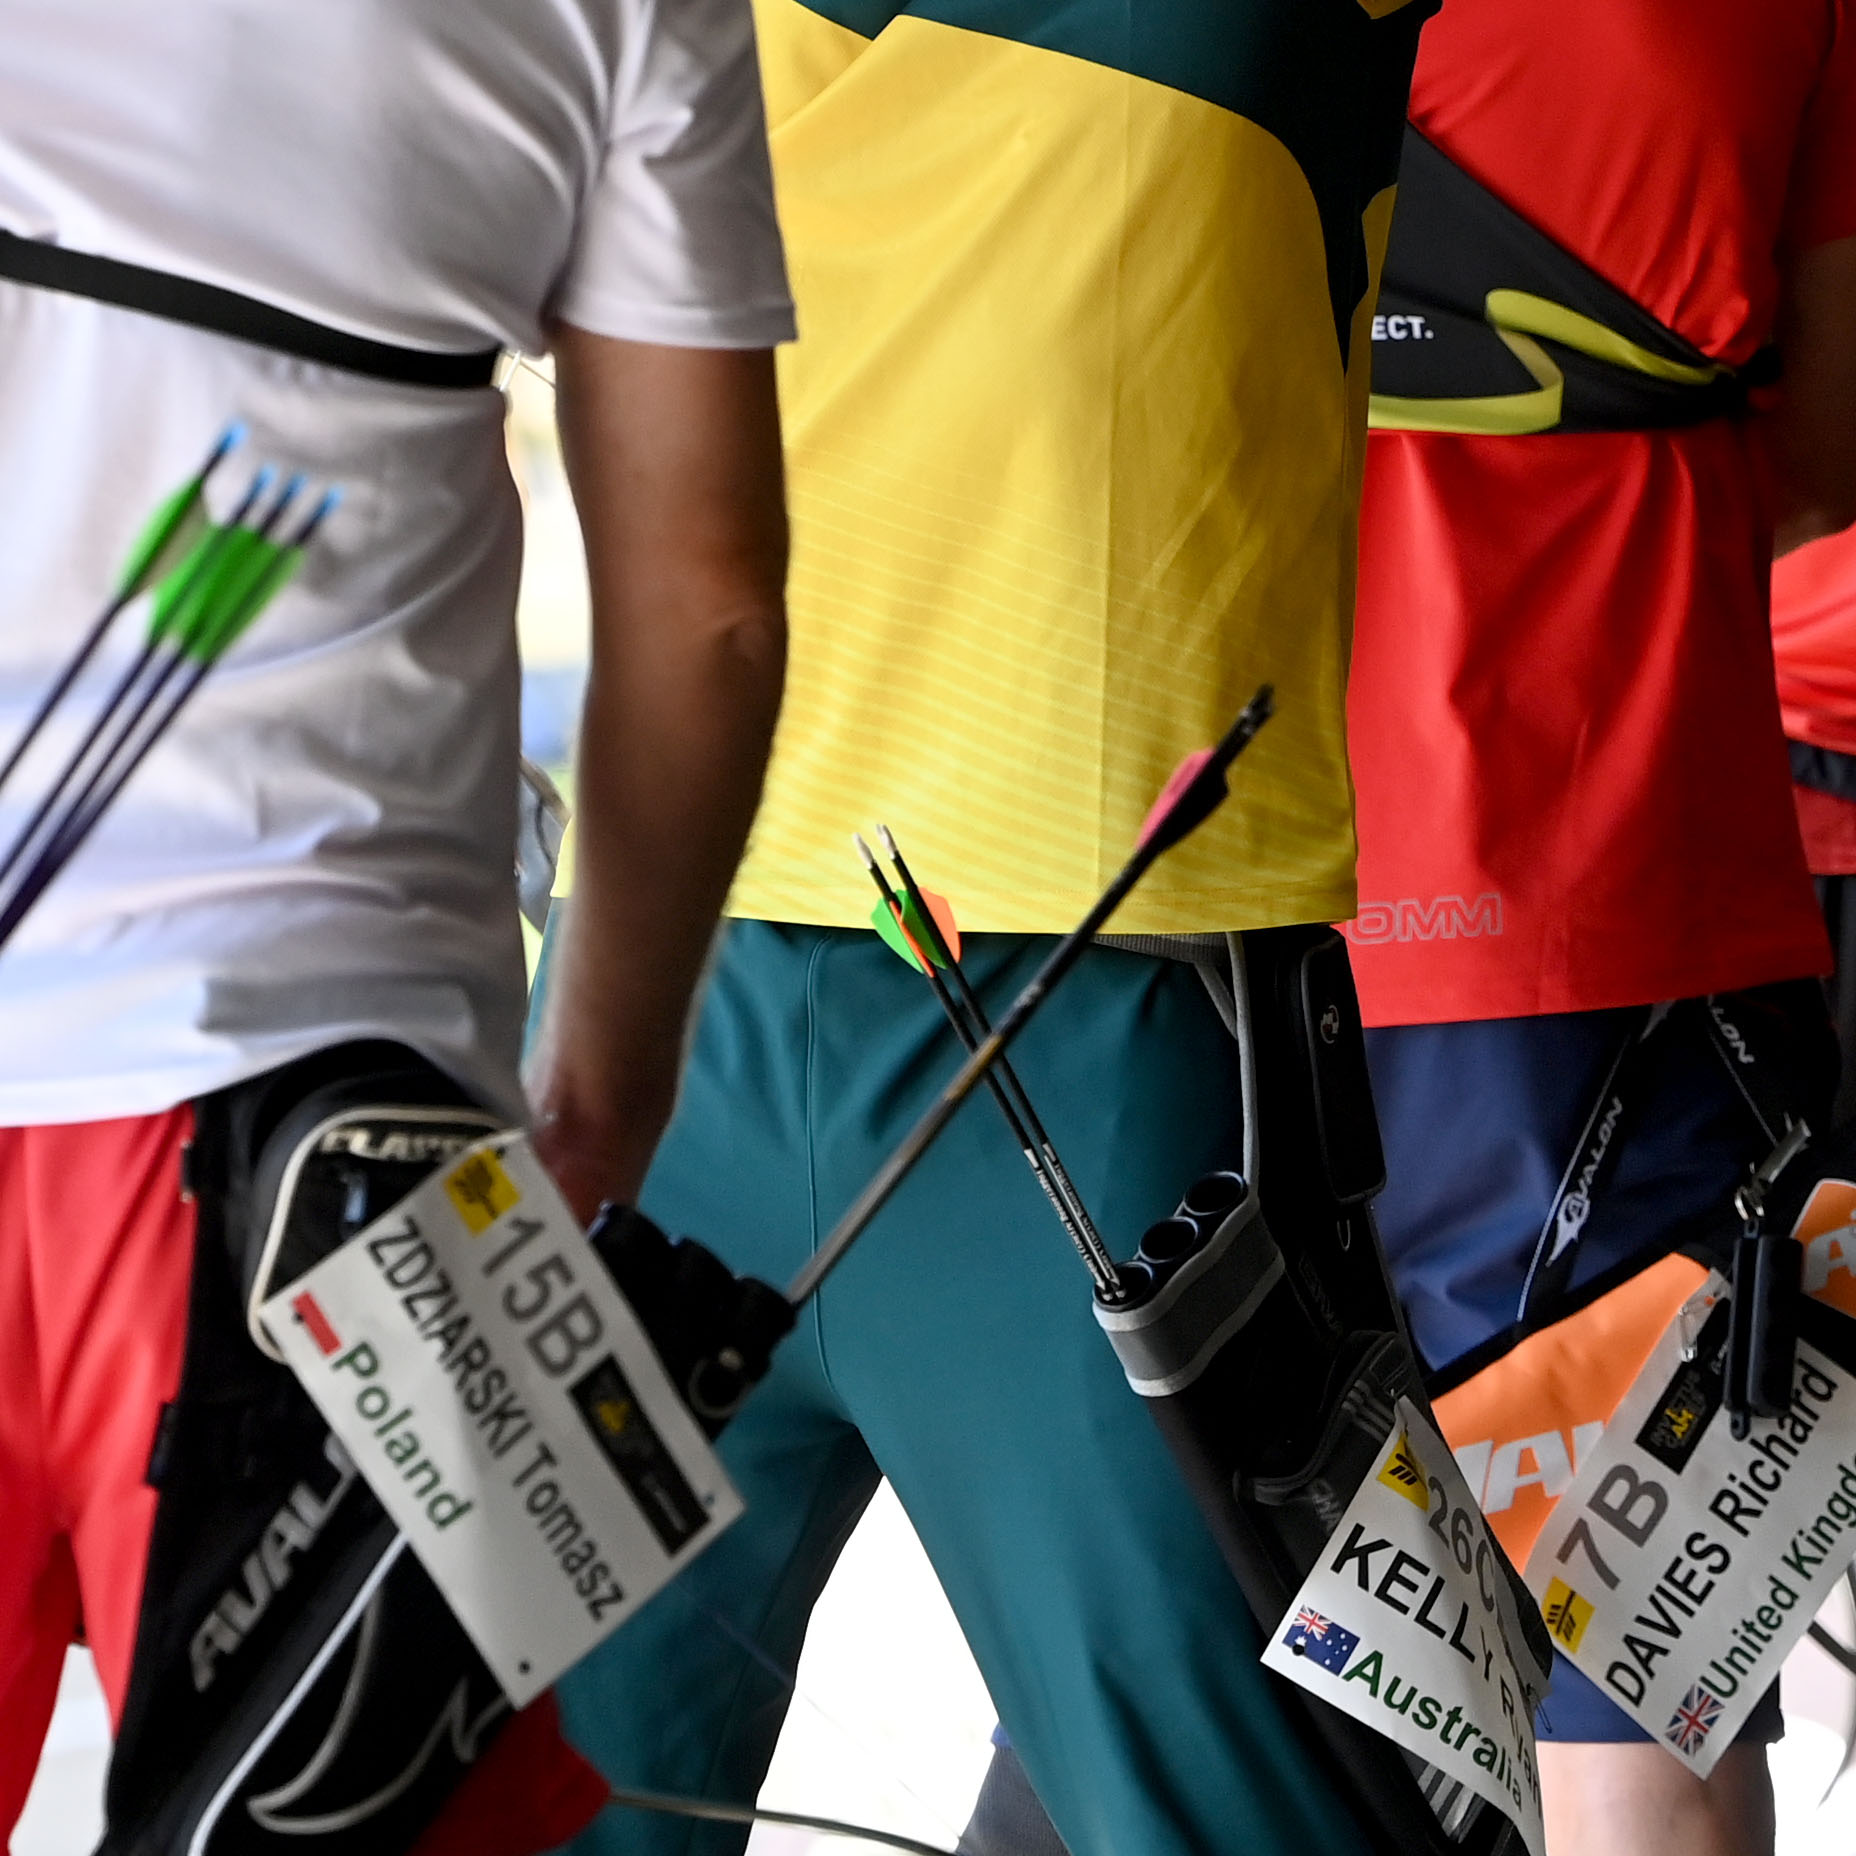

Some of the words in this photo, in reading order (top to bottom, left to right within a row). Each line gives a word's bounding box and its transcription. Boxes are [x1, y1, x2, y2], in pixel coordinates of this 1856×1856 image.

[1371, 314, 1434, 341] ECT.
[482, 1215, 604, 1378] 15B
[331, 1341, 473, 1534] Poland
[366, 1214, 534, 1462] ZDZIARSKI
[511, 1442, 627, 1622] Tomasz
[1330, 1523, 1494, 1683] KELLY
[1555, 1463, 1669, 1591] 7B
[1605, 1531, 1731, 1708] DAVIES
[1708, 1358, 1839, 1537] Richard
[1699, 1574, 1800, 1700] United
[1342, 1650, 1523, 1813] Australia
